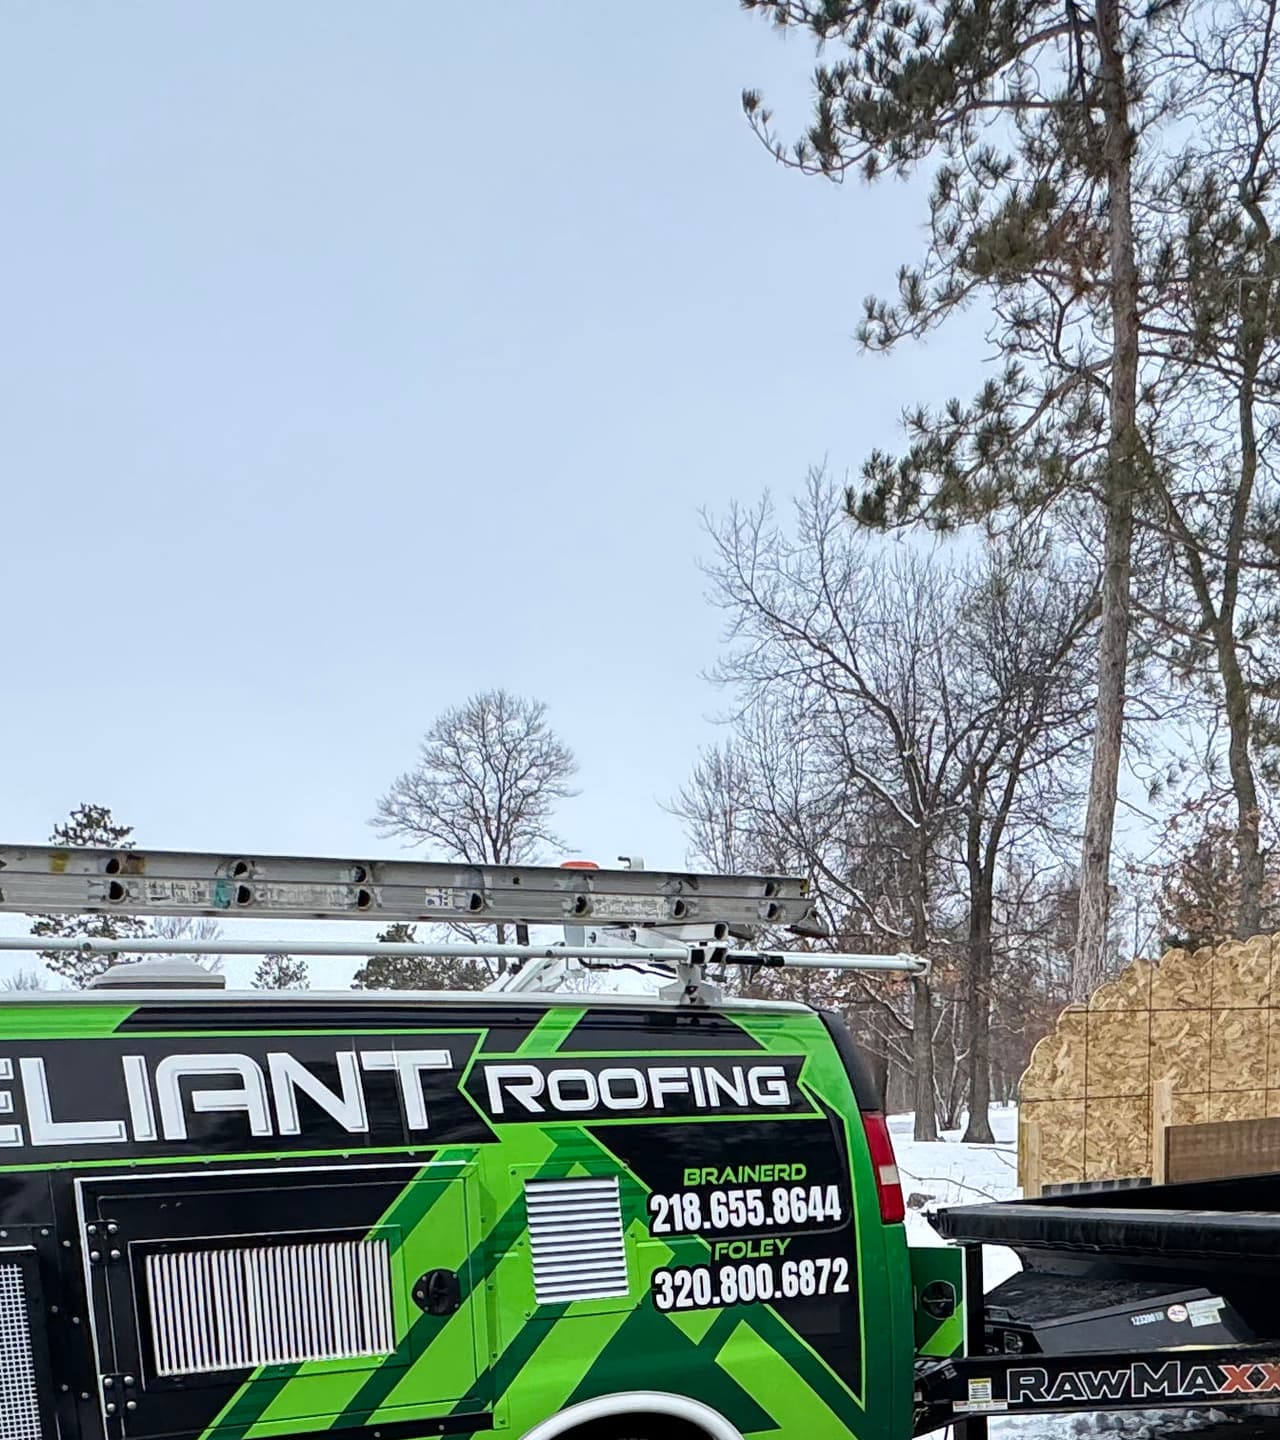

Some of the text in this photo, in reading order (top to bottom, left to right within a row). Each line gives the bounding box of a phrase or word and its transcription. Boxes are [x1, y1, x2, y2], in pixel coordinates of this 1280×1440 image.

[483, 1065, 791, 1115] ROOFING
[683, 1163, 807, 1187] BRAINERD
[649, 1184, 842, 1233] 218.655.8644
[714, 1237, 793, 1262] FOLEY
[653, 1257, 850, 1310] 320.800.6872
